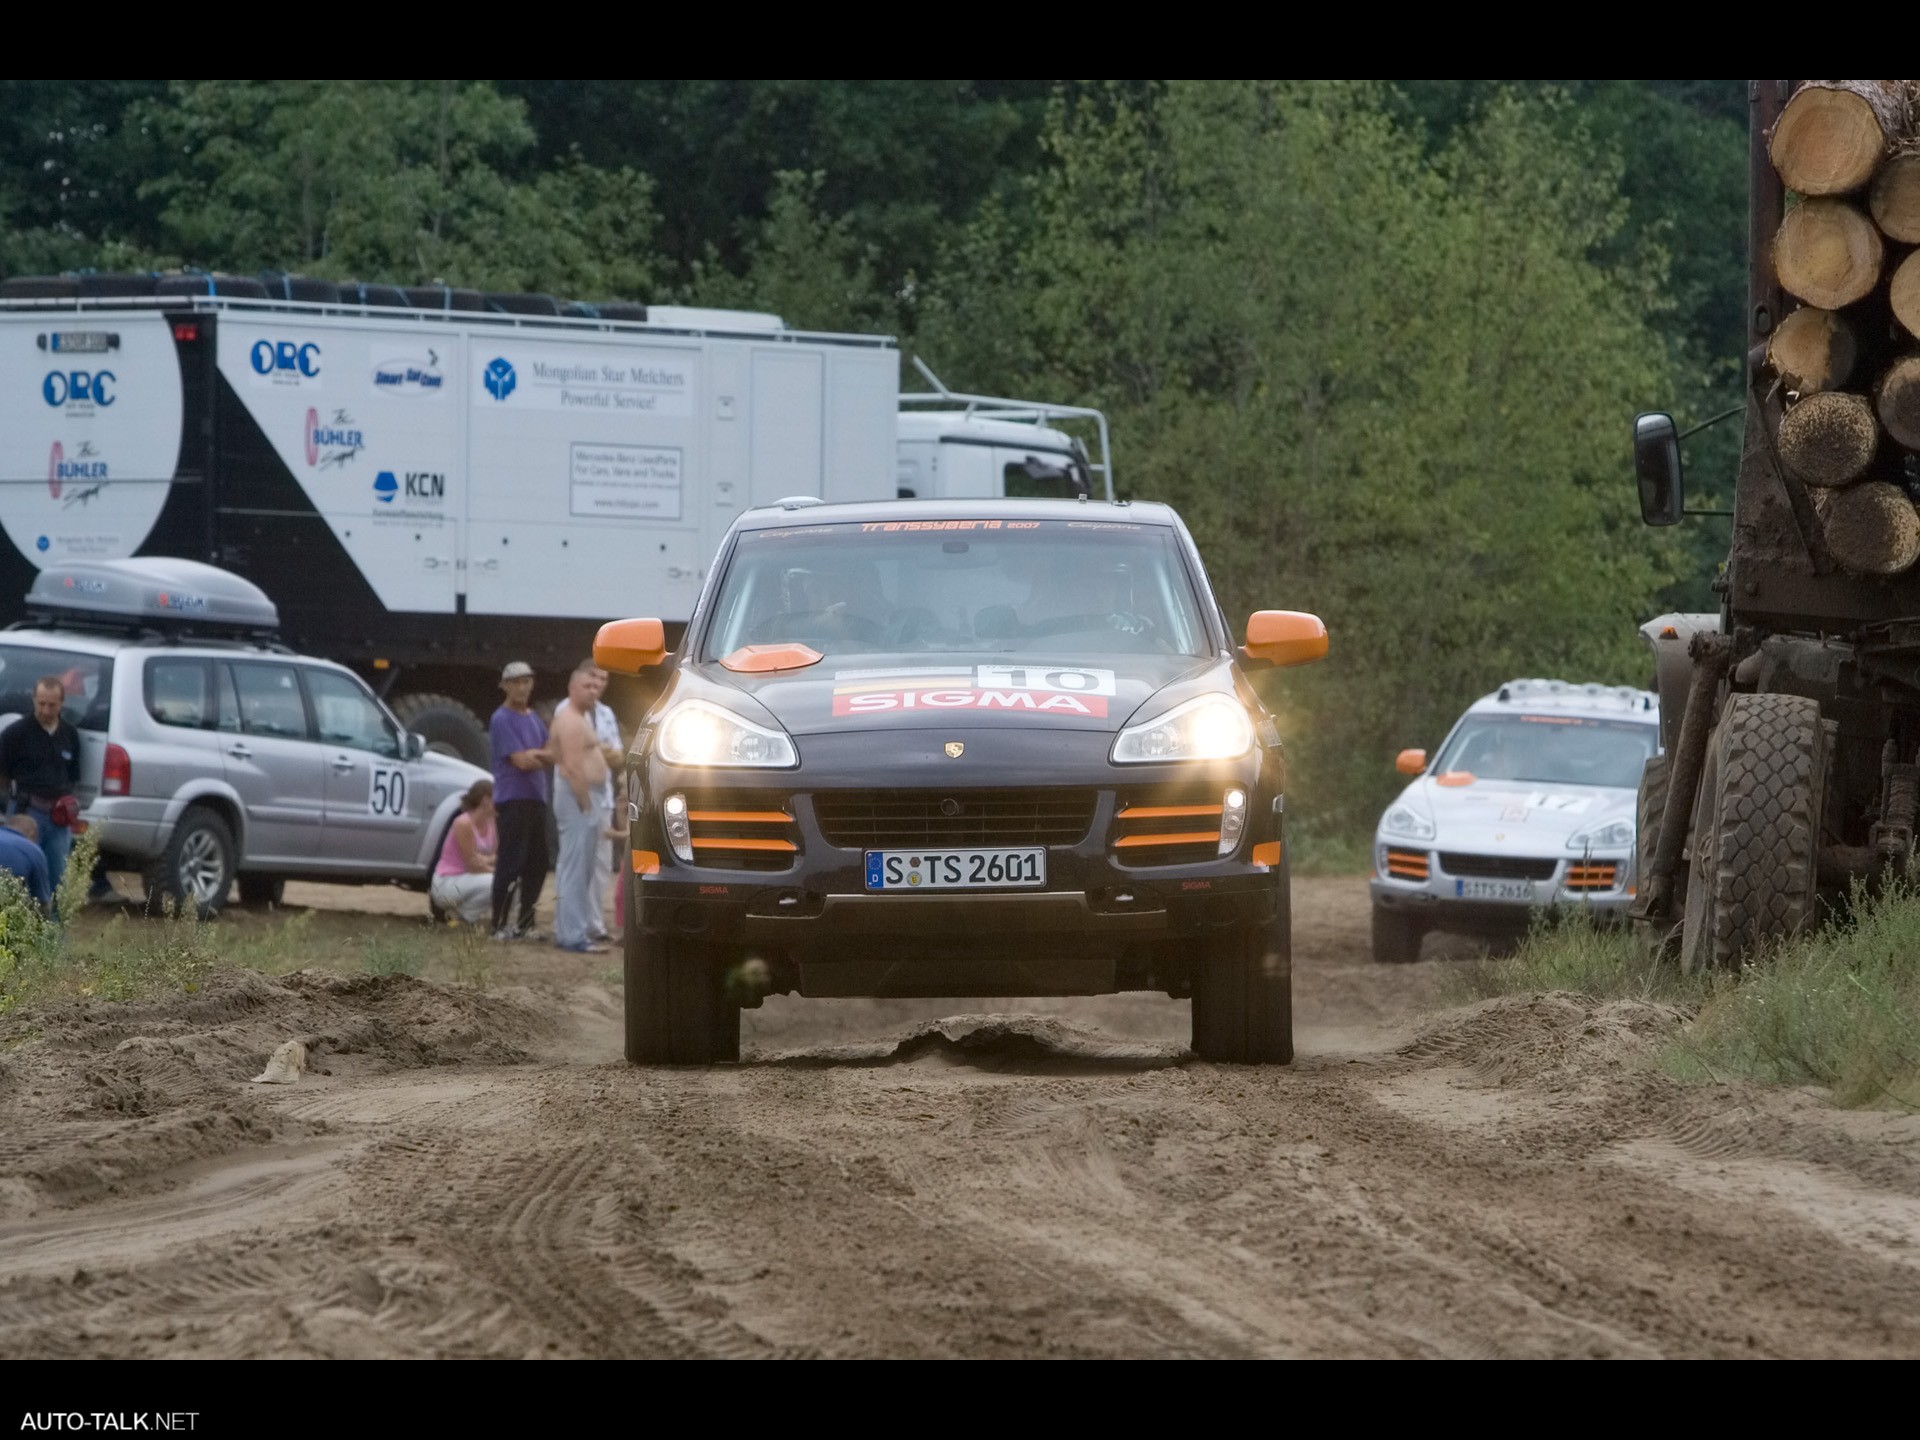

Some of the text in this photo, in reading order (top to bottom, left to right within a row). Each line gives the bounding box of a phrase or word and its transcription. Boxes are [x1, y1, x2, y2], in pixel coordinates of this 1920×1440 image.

[251, 340, 321, 377] ORC
[533, 362, 596, 383] Mongolian
[601, 365, 625, 383] Star
[43, 370, 116, 406] ORC
[560, 390, 609, 407] Powerful
[313, 424, 362, 447] BÜHLER
[56, 459, 108, 478] BÜHLER
[405, 472, 444, 497] KCN
[861, 520, 1003, 532] Transsyberia
[1067, 521, 1142, 530] Cayenne
[992, 670, 1100, 690] 10
[849, 690, 1091, 713] SIGMA
[372, 770, 405, 816] 50
[969, 853, 1041, 883] 2601
[699, 886, 728, 894] SIGMA
[1182, 881, 1211, 890] SIGMA
